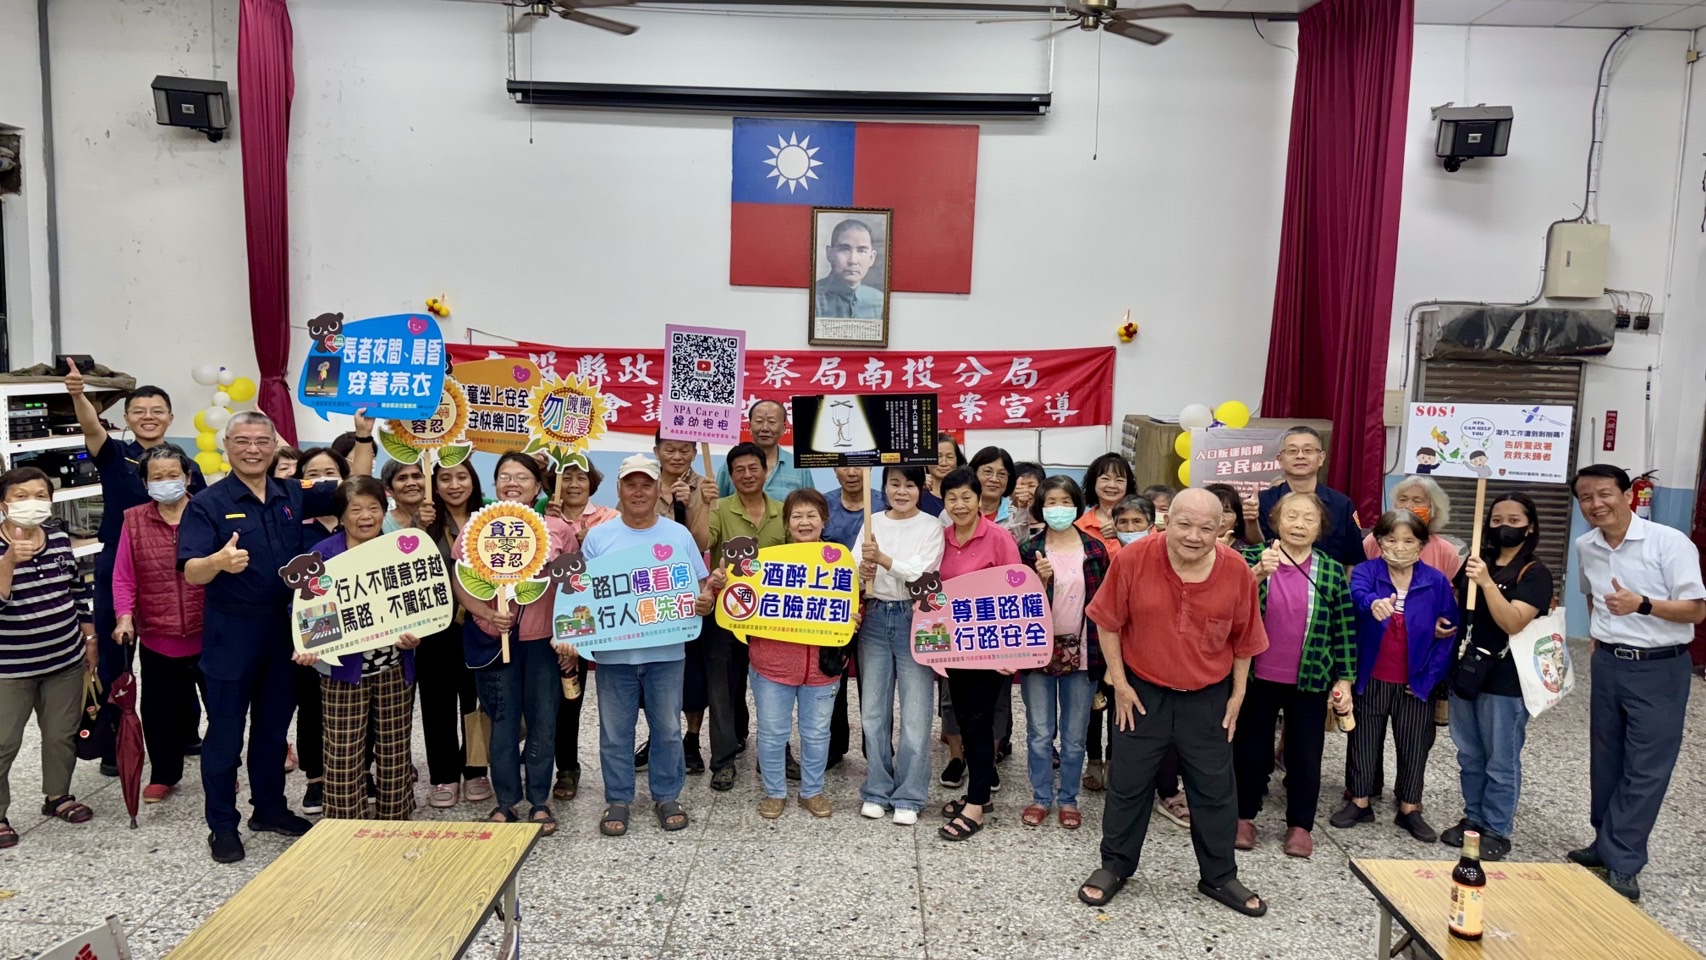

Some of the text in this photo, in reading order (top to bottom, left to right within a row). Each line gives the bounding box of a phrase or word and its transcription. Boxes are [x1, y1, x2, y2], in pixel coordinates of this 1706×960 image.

[342, 337, 442, 366] 長者夜間、晨昏
[347, 370, 433, 397] 穿著亮衣
[462, 385, 529, 408] 童坐上安全
[543, 393, 563, 430] 勿
[673, 405, 730, 418] NPA Care U
[673, 415, 729, 430] 婦幼抱抱
[1415, 405, 1455, 418] SOS!
[411, 419, 445, 434] 容忍
[563, 416, 588, 436] 飲宴
[1195, 445, 1264, 461] 人口販運陷阱
[1503, 451, 1553, 462] 救救未歸者
[490, 521, 524, 536] 貪污
[490, 553, 523, 567] 容忍
[334, 553, 445, 604] 行人不隨意穿越
[591, 564, 690, 599] 路口慢看停
[761, 562, 853, 592] 酒醉上道
[737, 588, 752, 603] 酒
[597, 593, 695, 630] 行人優先行
[759, 593, 851, 623] 危險就到
[951, 592, 1045, 623] 尊重路權
[954, 622, 1048, 651] 行路安全
